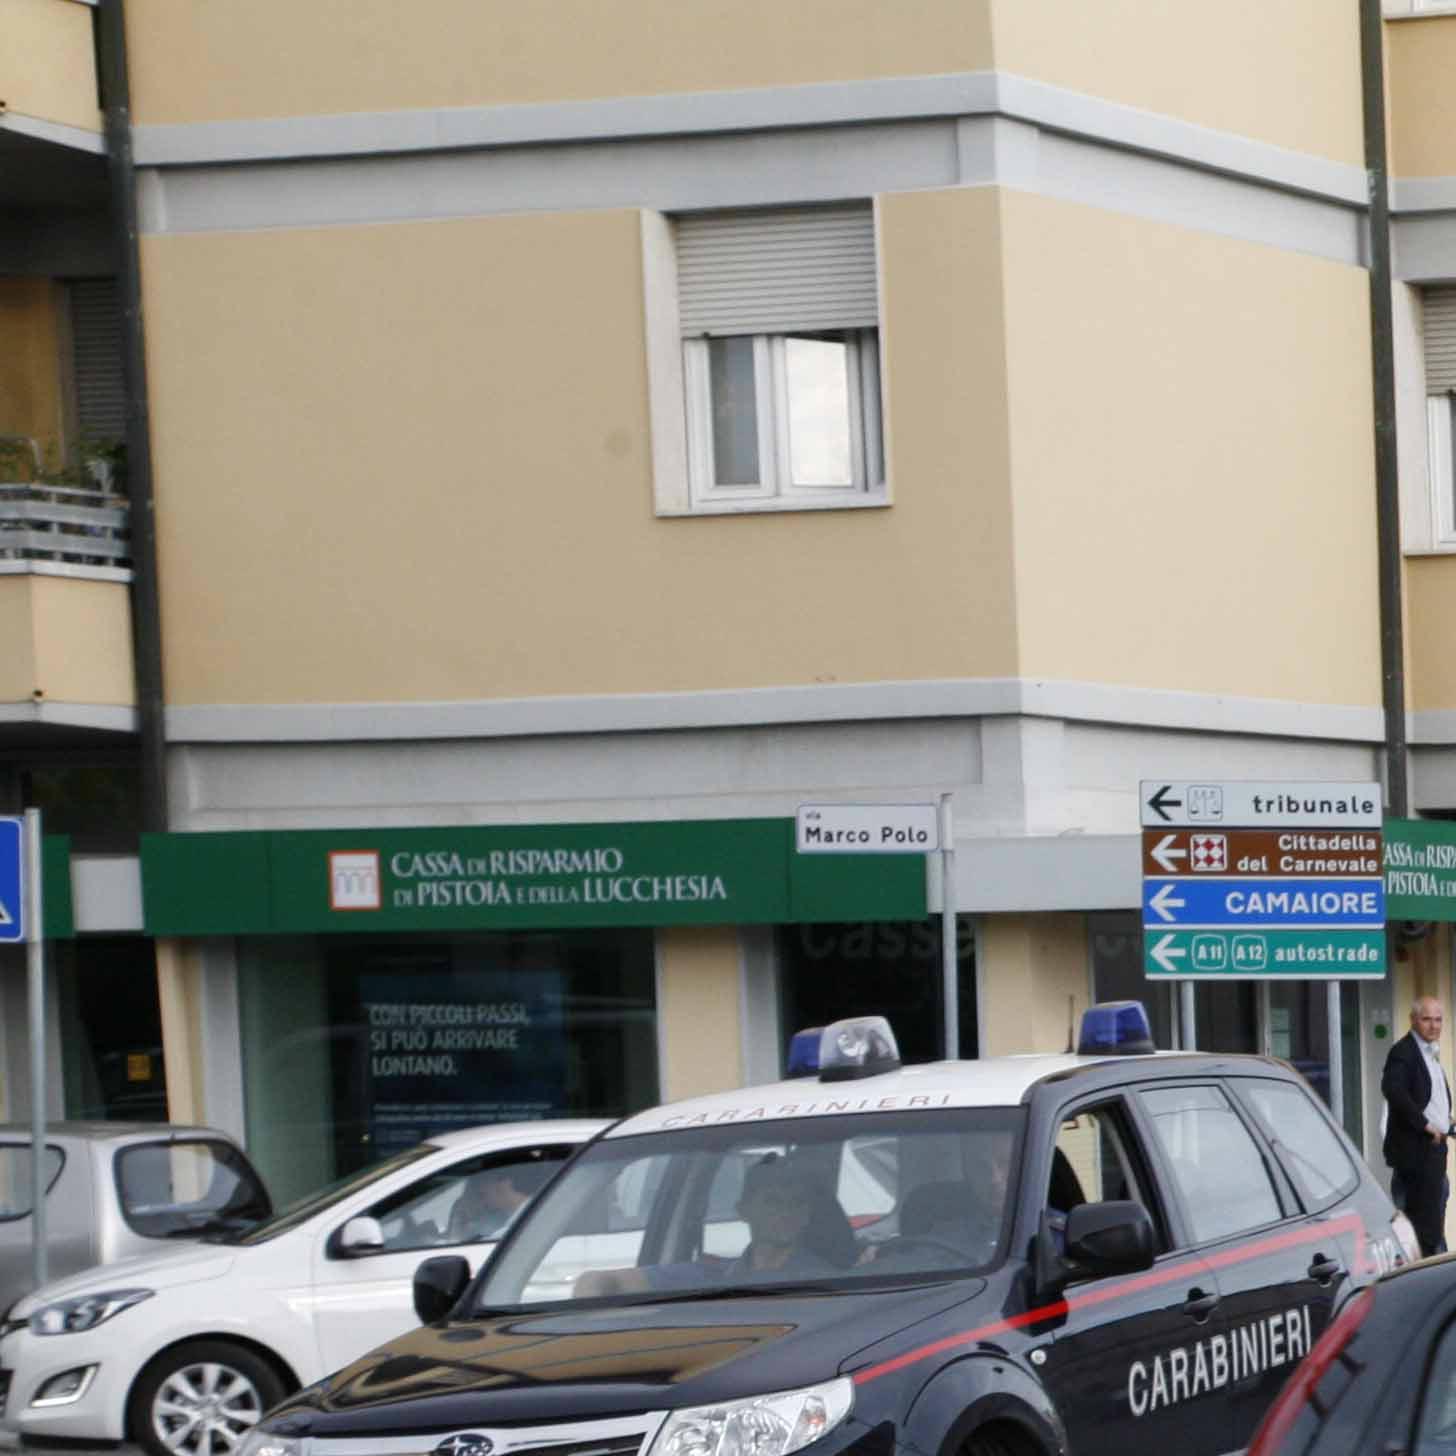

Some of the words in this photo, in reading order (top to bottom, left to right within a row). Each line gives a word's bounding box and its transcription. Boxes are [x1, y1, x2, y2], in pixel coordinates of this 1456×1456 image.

[805, 811, 821, 821] via
[1252, 794, 1375, 815] tribunale
[805, 826, 871, 844] Marco
[881, 826, 929, 844] Polo
[1278, 834, 1377, 852] Cittadella
[391, 851, 465, 878] CASSA
[489, 847, 623, 876] RISPARMIO
[1237, 855, 1268, 873] del
[1279, 855, 1378, 873] Carnevale
[1383, 841, 1413, 868] ASSA
[416, 879, 511, 907] PISTOIA
[583, 875, 727, 903] LUCCHESIA
[1387, 871, 1438, 897] PISTOIA
[1224, 891, 1378, 915] CAMAIORE
[1274, 943, 1379, 962] autostrade
[369, 1029, 388, 1051] SI
[432, 1028, 520, 1050] ARRIVARE
[1127, 1303, 1313, 1417] CARABINIERI
